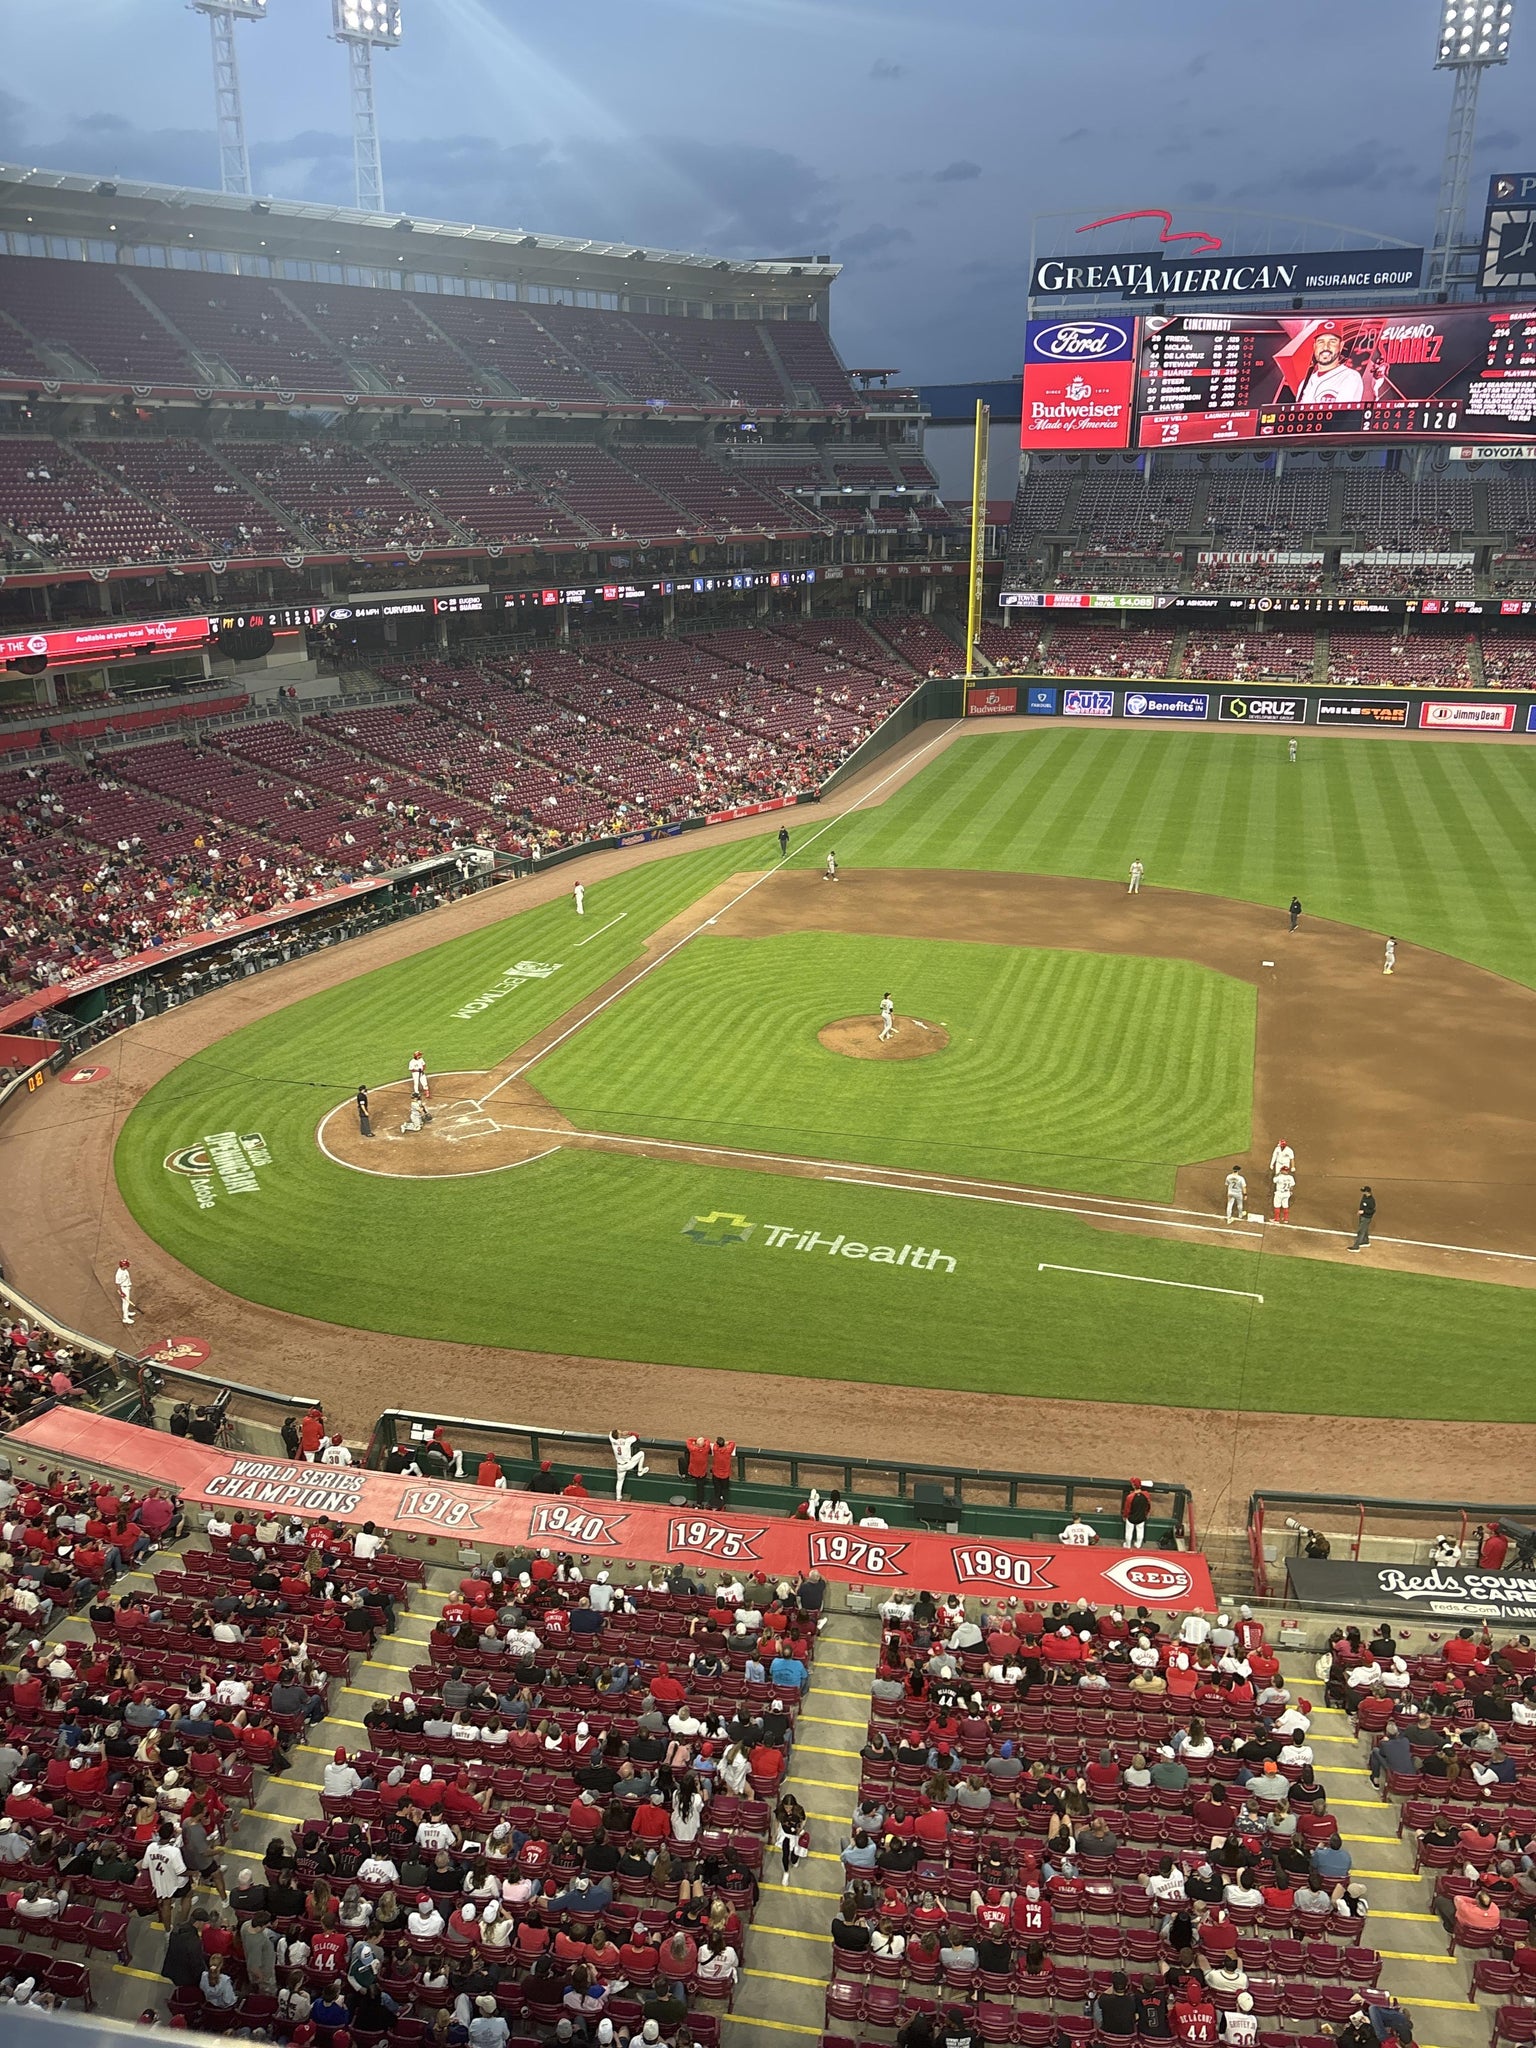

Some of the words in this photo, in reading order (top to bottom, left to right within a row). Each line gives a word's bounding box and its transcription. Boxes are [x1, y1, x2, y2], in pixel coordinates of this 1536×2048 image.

[1305, 271, 1373, 288] INSURANCE
[1374, 271, 1413, 286] GROUP
[1183, 318, 1232, 331] CINCINNATI
[1381, 324, 1435, 341] EUGENIO
[1050, 327, 1110, 354] Ford
[1160, 394, 1202, 402] STEPHENSON
[1031, 401, 1122, 418] Budweiser
[1204, 412, 1231, 420] LAUNCH
[1364, 410, 1372, 419] 0
[1028, 418, 1062, 431] Made
[1063, 418, 1074, 432] of
[1073, 417, 1119, 430] America
[1220, 420, 1233, 431] -1
[1362, 421, 1370, 431] 2
[1422, 413, 1430, 428] 1
[1434, 412, 1443, 429] 2
[1447, 412, 1457, 429] 0
[1161, 424, 1180, 436] 73
[1477, 447, 1524, 458] TOYOTA
[1234, 553, 1241, 562] K
[1246, 553, 1252, 562] K
[1268, 553, 1275, 562] K
[458, 597, 481, 605] EUGENIO
[1119, 597, 1153, 607] $4,085
[366, 608, 380, 616] MPH
[383, 605, 426, 615] CURVEBALL
[237, 617, 245, 628] 0
[249, 616, 264, 628] CIN
[269, 615, 277, 625] 2
[75, 633, 106, 643] Available
[114, 632, 128, 640] your
[128, 629, 144, 637] local
[155, 622, 178, 640] Kroger
[6, 641, 25, 652] THE
[970, 703, 1015, 714] Budweiser
[1148, 700, 1194, 712] Benefits
[1249, 700, 1296, 716] CRUZ
[1320, 706, 1406, 717] MILESTAR
[1453, 709, 1480, 721] Jimmy
[1480, 710, 1500, 720] Dean
[203, 1131, 251, 1175] OPENING
[247, 1148, 273, 1167] 2026
[220, 1170, 261, 1195] DAY
[189, 1178, 218, 1210] Adobe
[763, 1223, 958, 1274] TriHealth
[329, 1455, 340, 1464] 30
[229, 1459, 298, 1482] WORLD
[297, 1469, 368, 1492] SERIES
[204, 1475, 362, 1515] CHAMPIONS
[408, 1491, 471, 1525] 1919
[827, 1511, 840, 1520] 44
[537, 1506, 605, 1540] 1940
[311, 1540, 324, 1548] 44
[675, 1521, 744, 1556] 1975
[815, 1535, 884, 1572] 1976
[958, 1549, 1032, 1585] 1990
[1129, 1571, 1188, 1586] REDS
[1377, 1568, 1467, 1598] Reds
[1463, 1574, 1536, 1591] COUN
[938, 1695, 953, 1707] 44
[424, 1840, 438, 1850] 19
[527, 1852, 539, 1864] 37
[155, 1862, 165, 1876] 4
[1026, 1904, 1042, 1913] ROSE
[982, 1911, 1006, 1923] BENCH
[1026, 1912, 1042, 1928] 14
[326, 1943, 340, 1953] CRUZ
[314, 1954, 336, 1971] 44
[713, 1964, 723, 1978] 7
[1179, 2016, 1187, 2024] DE
[1189, 2014, 1197, 2022] LA
[1197, 2014, 1213, 2024] CRUZ
[1230, 2020, 1250, 2029] GRIFFEY
[1187, 2025, 1208, 2041] 44
[1233, 2032, 1254, 2046] 30
